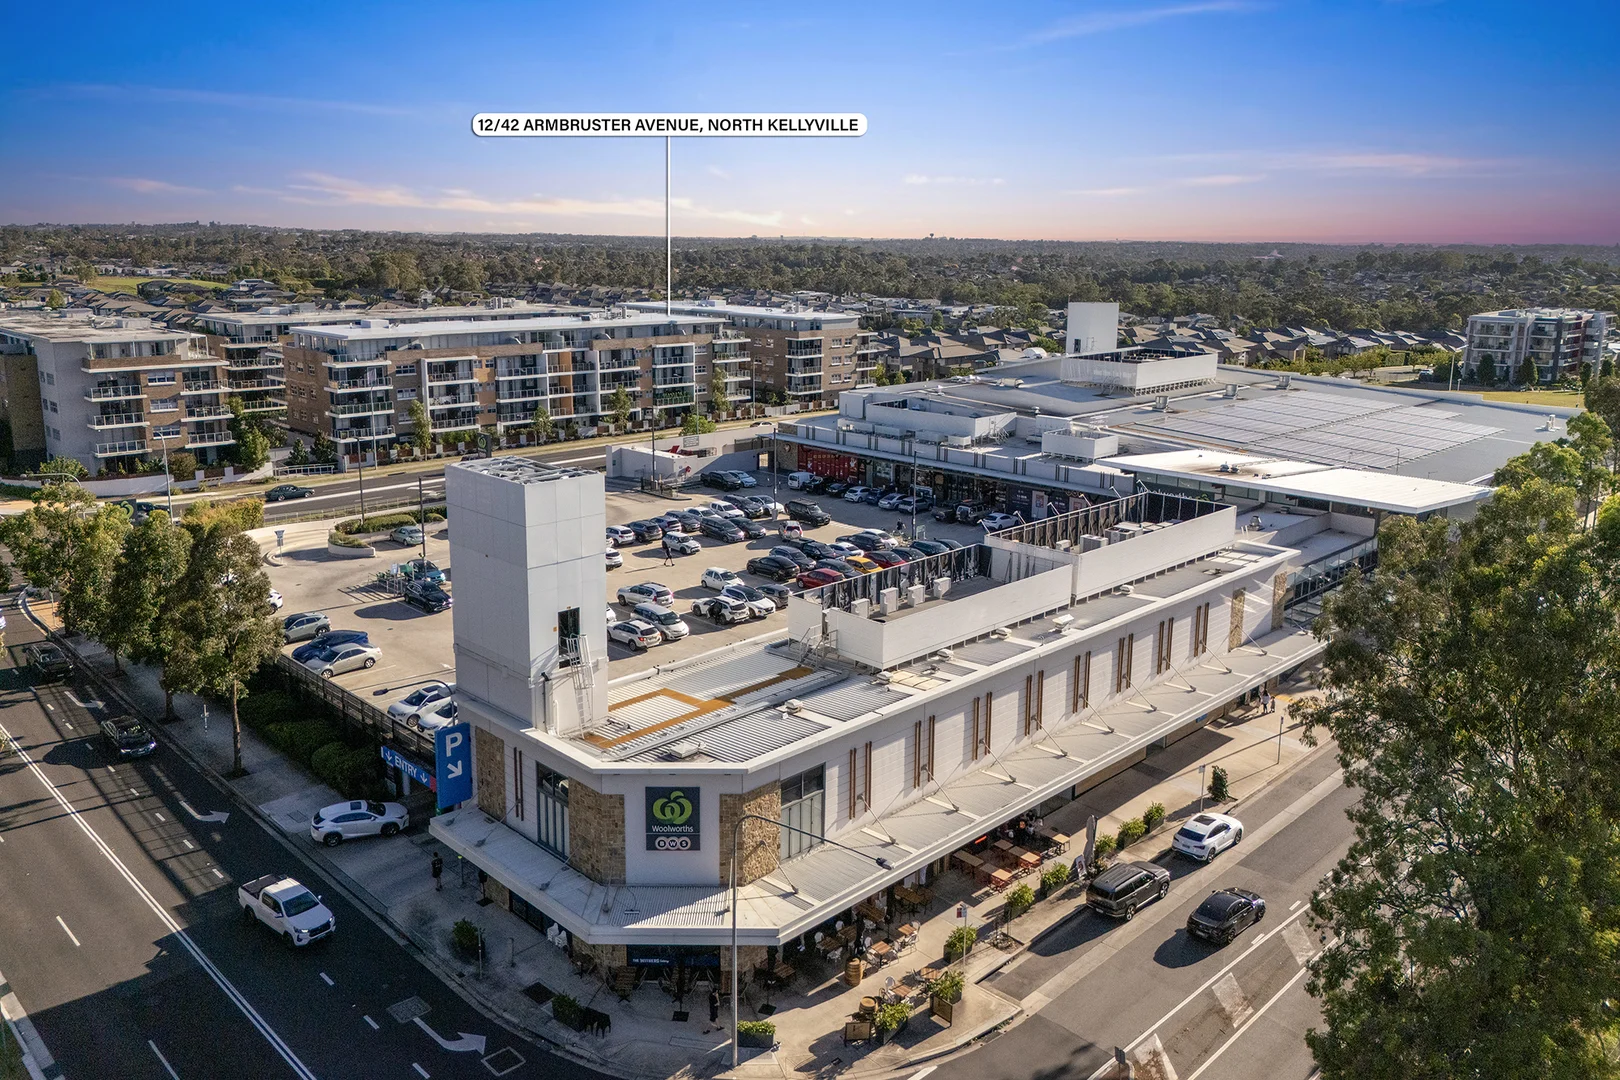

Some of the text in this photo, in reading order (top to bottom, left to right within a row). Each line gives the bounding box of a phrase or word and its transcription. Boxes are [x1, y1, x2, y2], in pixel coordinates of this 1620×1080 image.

[446, 732, 463, 757] P
[394, 755, 417, 778] ENTRY
[651, 824, 694, 833] Woolworths
